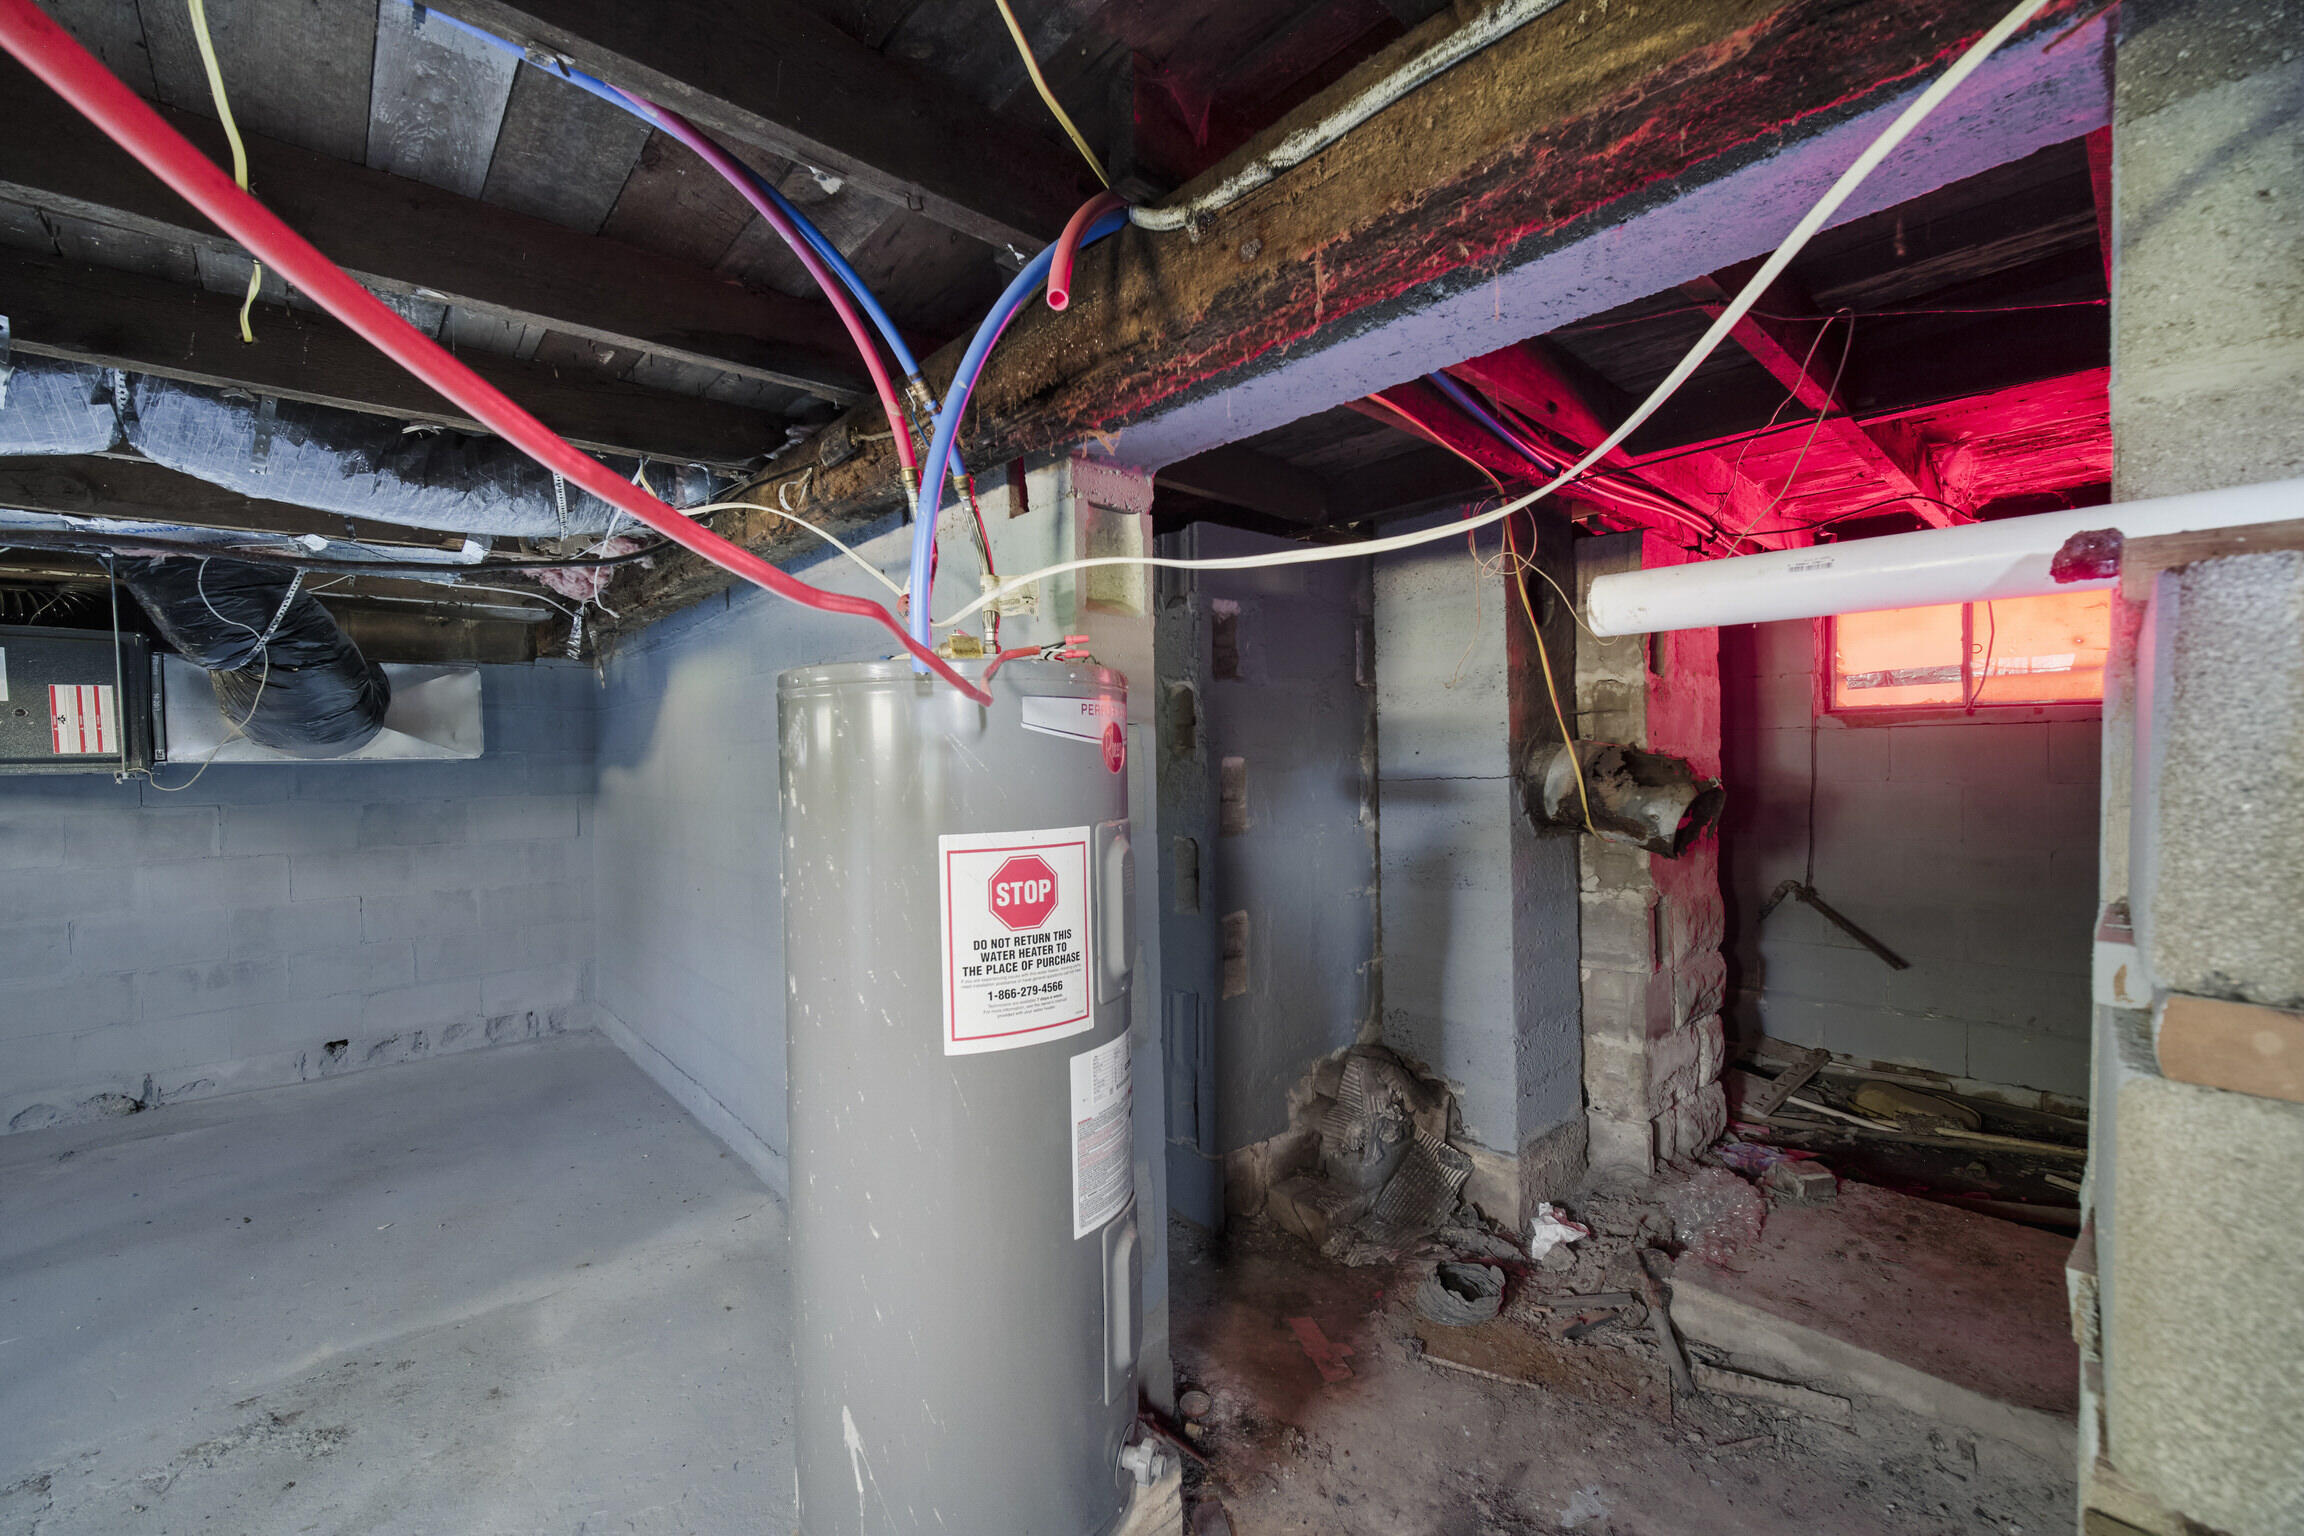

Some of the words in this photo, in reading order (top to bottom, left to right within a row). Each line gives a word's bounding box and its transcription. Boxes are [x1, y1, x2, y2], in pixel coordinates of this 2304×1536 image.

[996, 878, 1051, 907] STOP
[973, 939, 987, 951] DO
[991, 937, 1011, 949] NOT
[1014, 932, 1051, 947] RETURN
[1053, 928, 1072, 941] THIS
[962, 965, 982, 977] THE
[986, 961, 1018, 975] PLACE
[1021, 960, 1034, 971] OF
[1036, 951, 1081, 968] PURCHASE
[980, 949, 1016, 963] WATER
[1018, 944, 1054, 959] HEATER
[1056, 942, 1067, 953] TO
[987, 980, 1063, 1001] 1-866-279-4566
